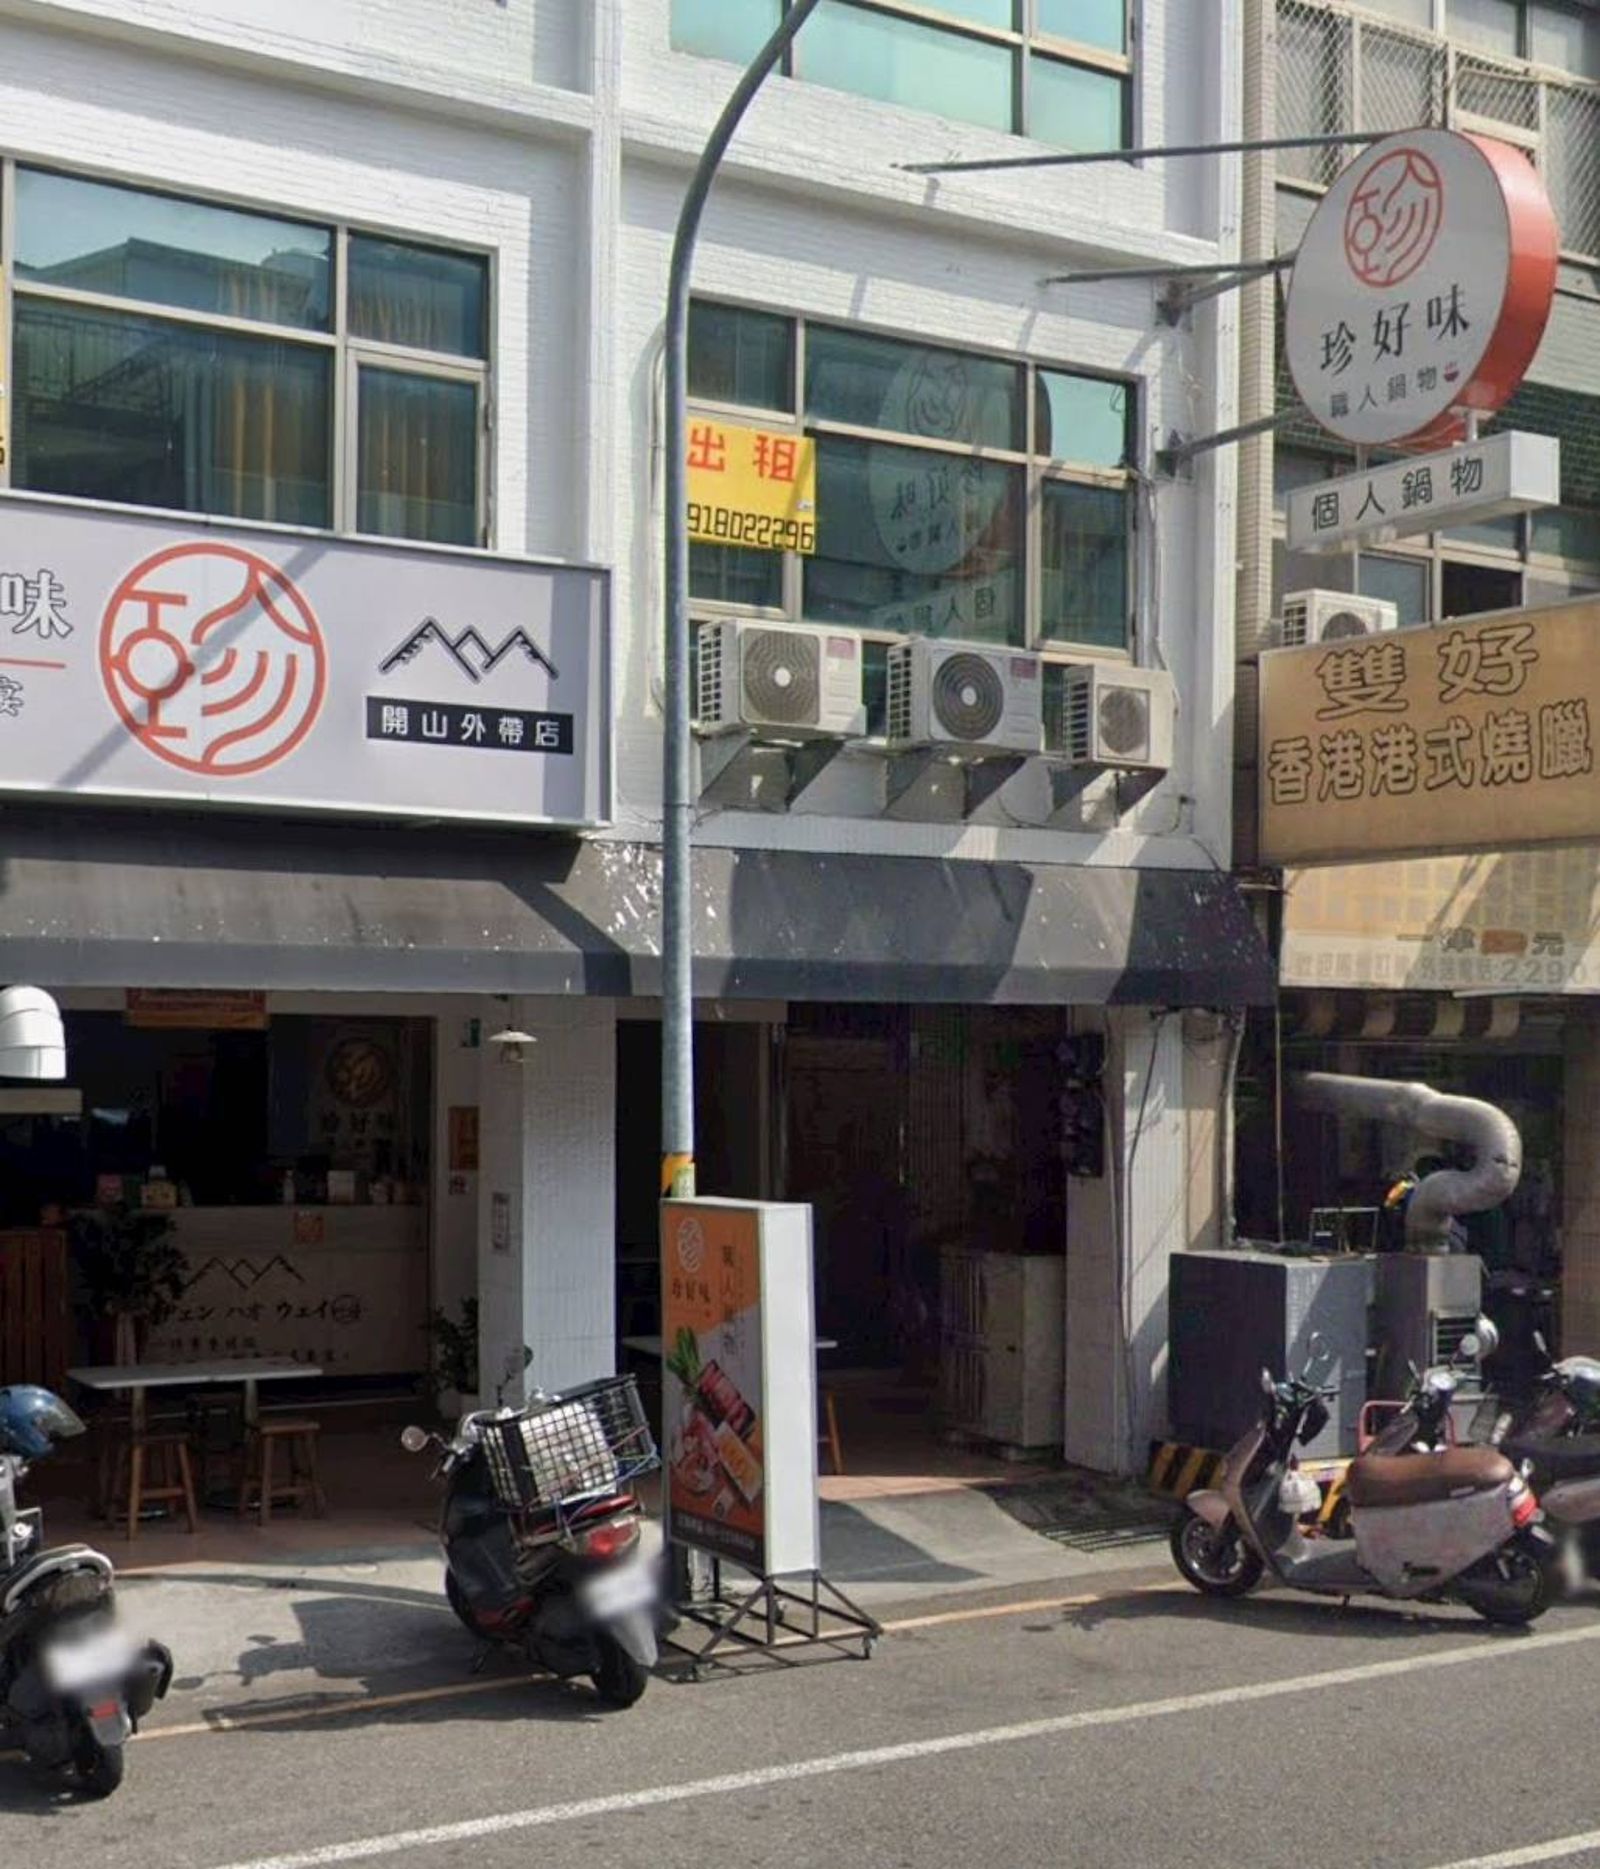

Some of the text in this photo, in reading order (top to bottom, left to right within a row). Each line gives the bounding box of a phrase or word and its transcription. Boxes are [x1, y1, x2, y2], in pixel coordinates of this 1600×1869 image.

[1319, 284, 1470, 377] 珍好味
[687, 426, 798, 482] 出租
[1310, 455, 1484, 534] 個人鍋物
[0, 568, 74, 640] 味
[1315, 622, 1540, 722] 雙好
[380, 704, 562, 749] 開山外帶店
[1267, 697, 1593, 806] 香港港式燒臘
